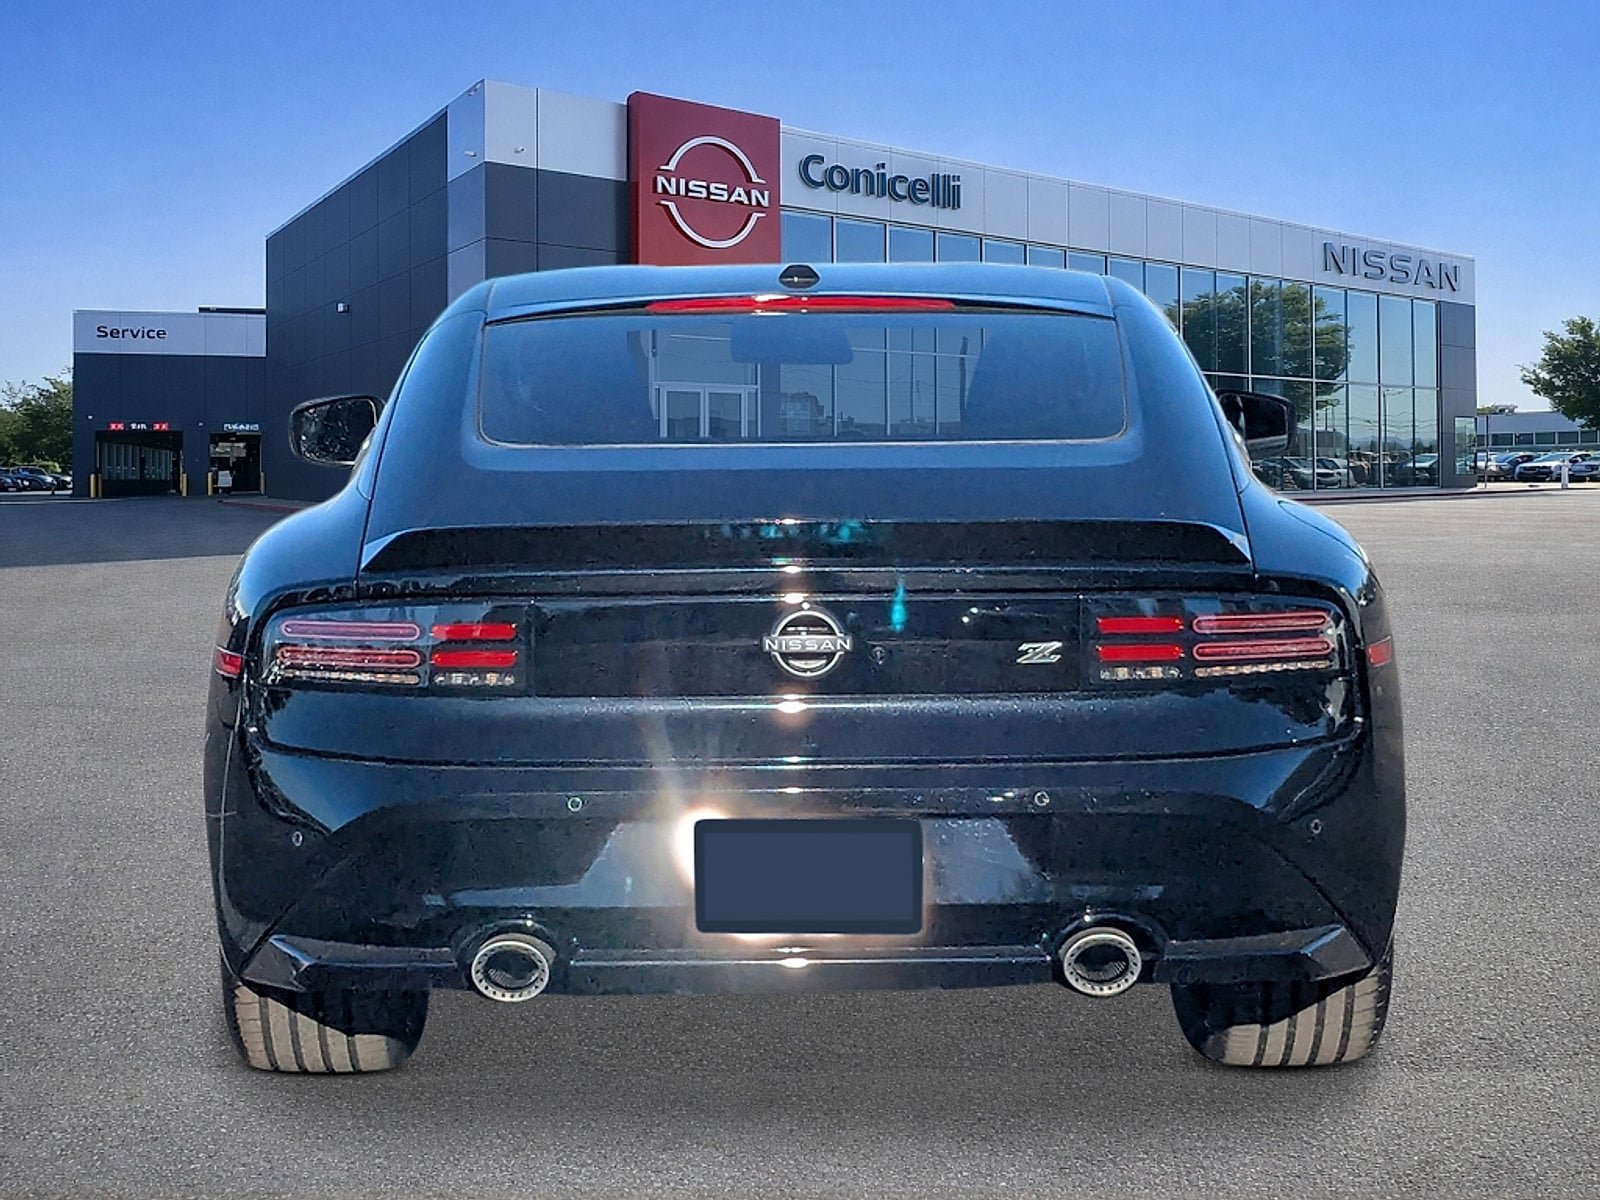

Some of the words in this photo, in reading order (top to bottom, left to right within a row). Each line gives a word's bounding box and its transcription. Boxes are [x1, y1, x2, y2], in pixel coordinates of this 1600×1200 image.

[655, 174, 769, 208] NISSAN
[799, 154, 961, 210] Conicelli
[1323, 242, 1460, 292] NISSAN
[96, 325, 167, 339] Service
[763, 638, 851, 651] NISSAN
